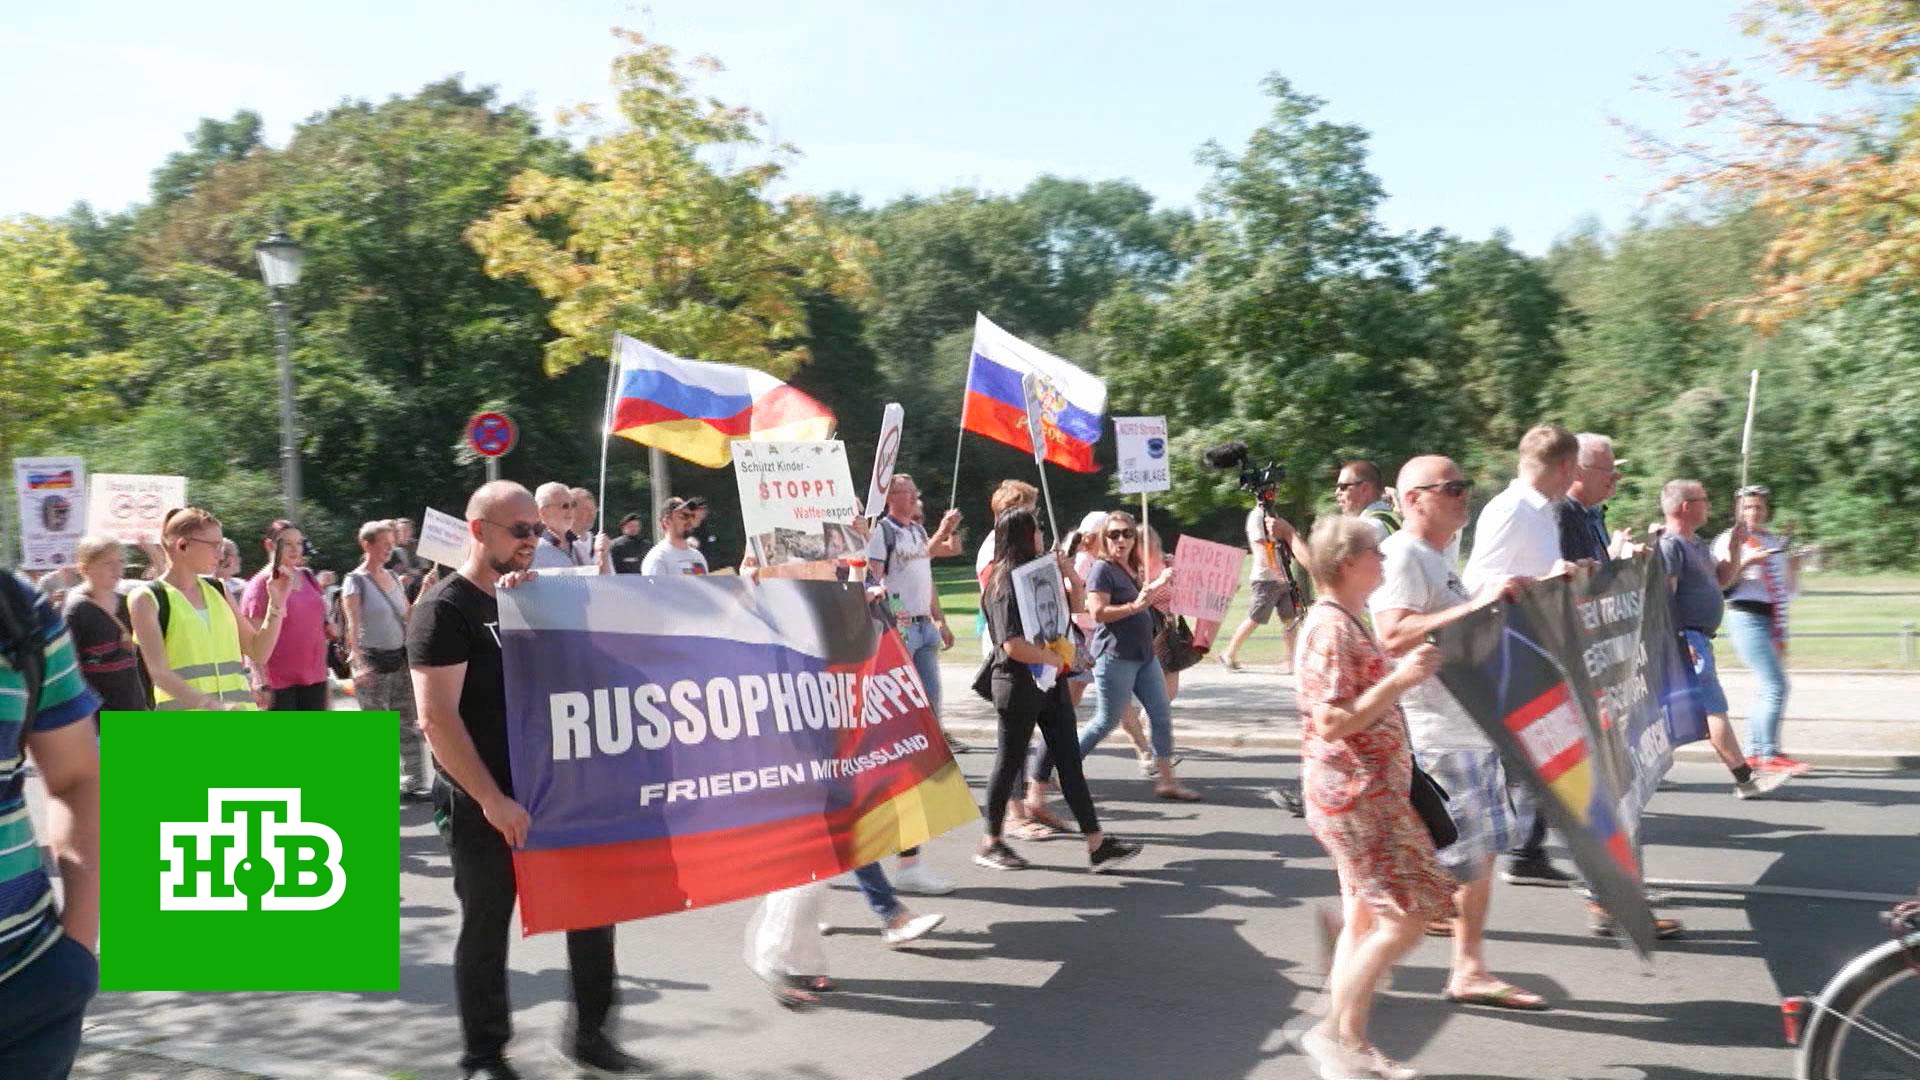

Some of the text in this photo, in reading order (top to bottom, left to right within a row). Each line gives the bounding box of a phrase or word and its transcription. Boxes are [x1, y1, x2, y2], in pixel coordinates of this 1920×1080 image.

[741, 461, 775, 473] Schützt
[777, 459, 804, 472] Kinder
[758, 479, 835, 500] STOPPT
[793, 506, 855, 519] Waffenexport
[549, 672, 858, 761] RUSSOPHOBIE
[640, 734, 929, 807] FRIEDEN MIT RUSSLAND
